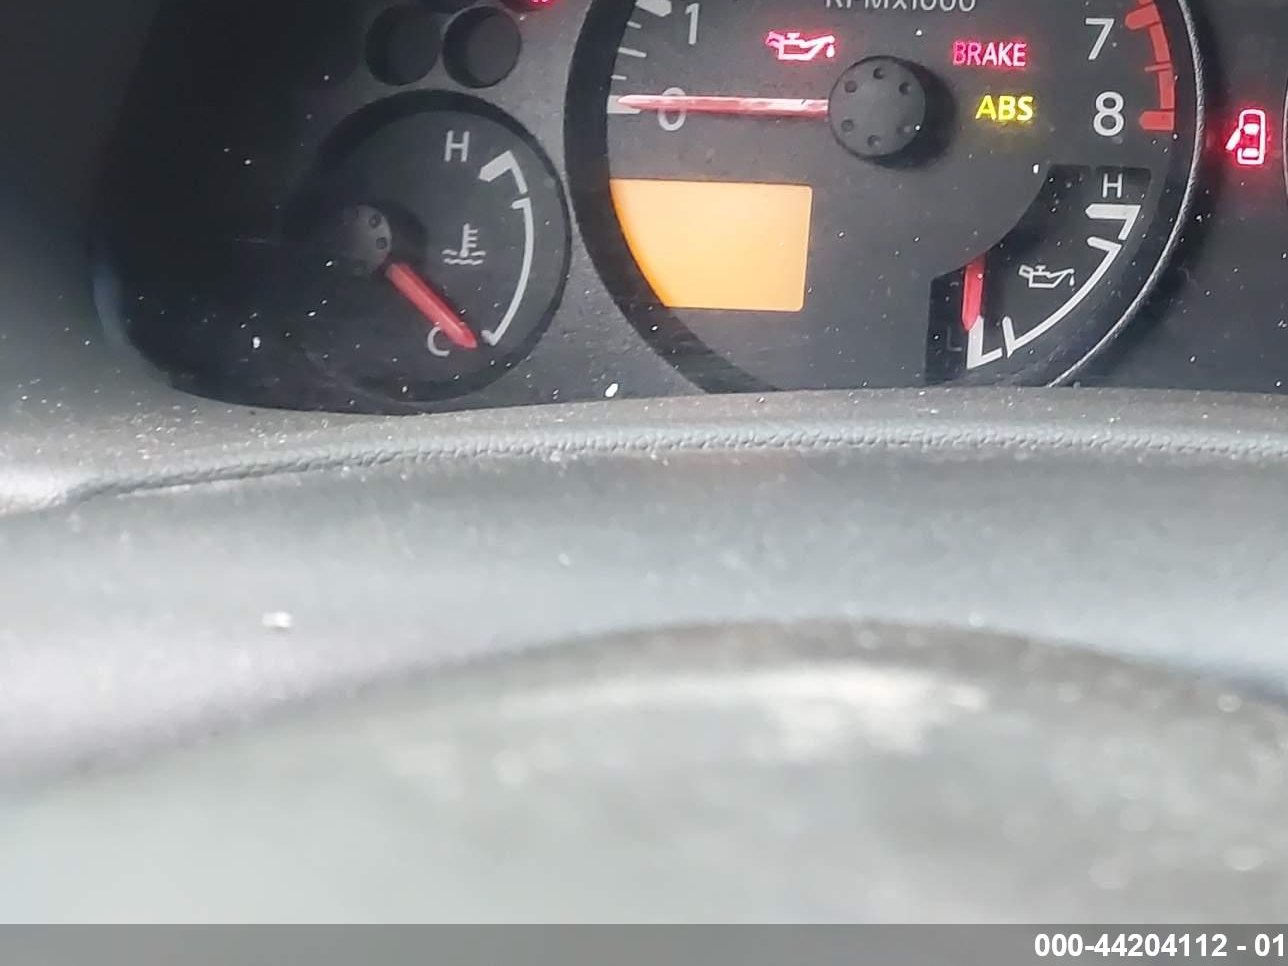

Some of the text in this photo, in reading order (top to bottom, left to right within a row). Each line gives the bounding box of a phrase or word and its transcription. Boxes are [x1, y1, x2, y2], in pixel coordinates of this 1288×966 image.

[685, 3, 700, 45] 1
[1085, 17, 1116, 61] 7
[952, 41, 1027, 67] BRAKE
[657, 87, 687, 131] 0
[975, 94, 1034, 122] ABS
[1093, 91, 1124, 137] 8
[444, 130, 470, 162] H
[1102, 172, 1123, 198] H
